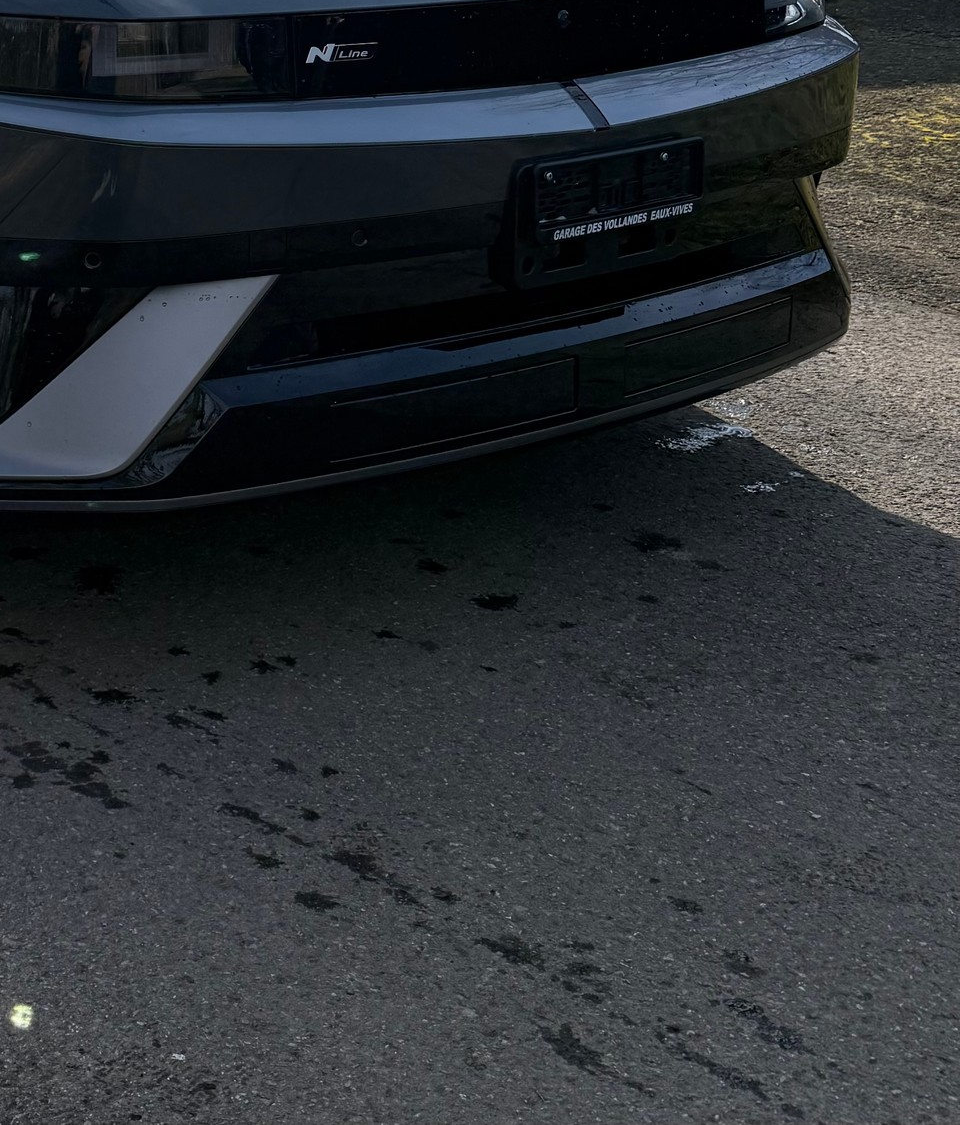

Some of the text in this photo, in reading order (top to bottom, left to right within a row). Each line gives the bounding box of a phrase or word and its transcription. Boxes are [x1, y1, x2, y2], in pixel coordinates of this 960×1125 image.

[305, 43, 369, 64] N Line
[553, 202, 694, 241] GARAGE DES VOLLANDES EAUX-VIVES
